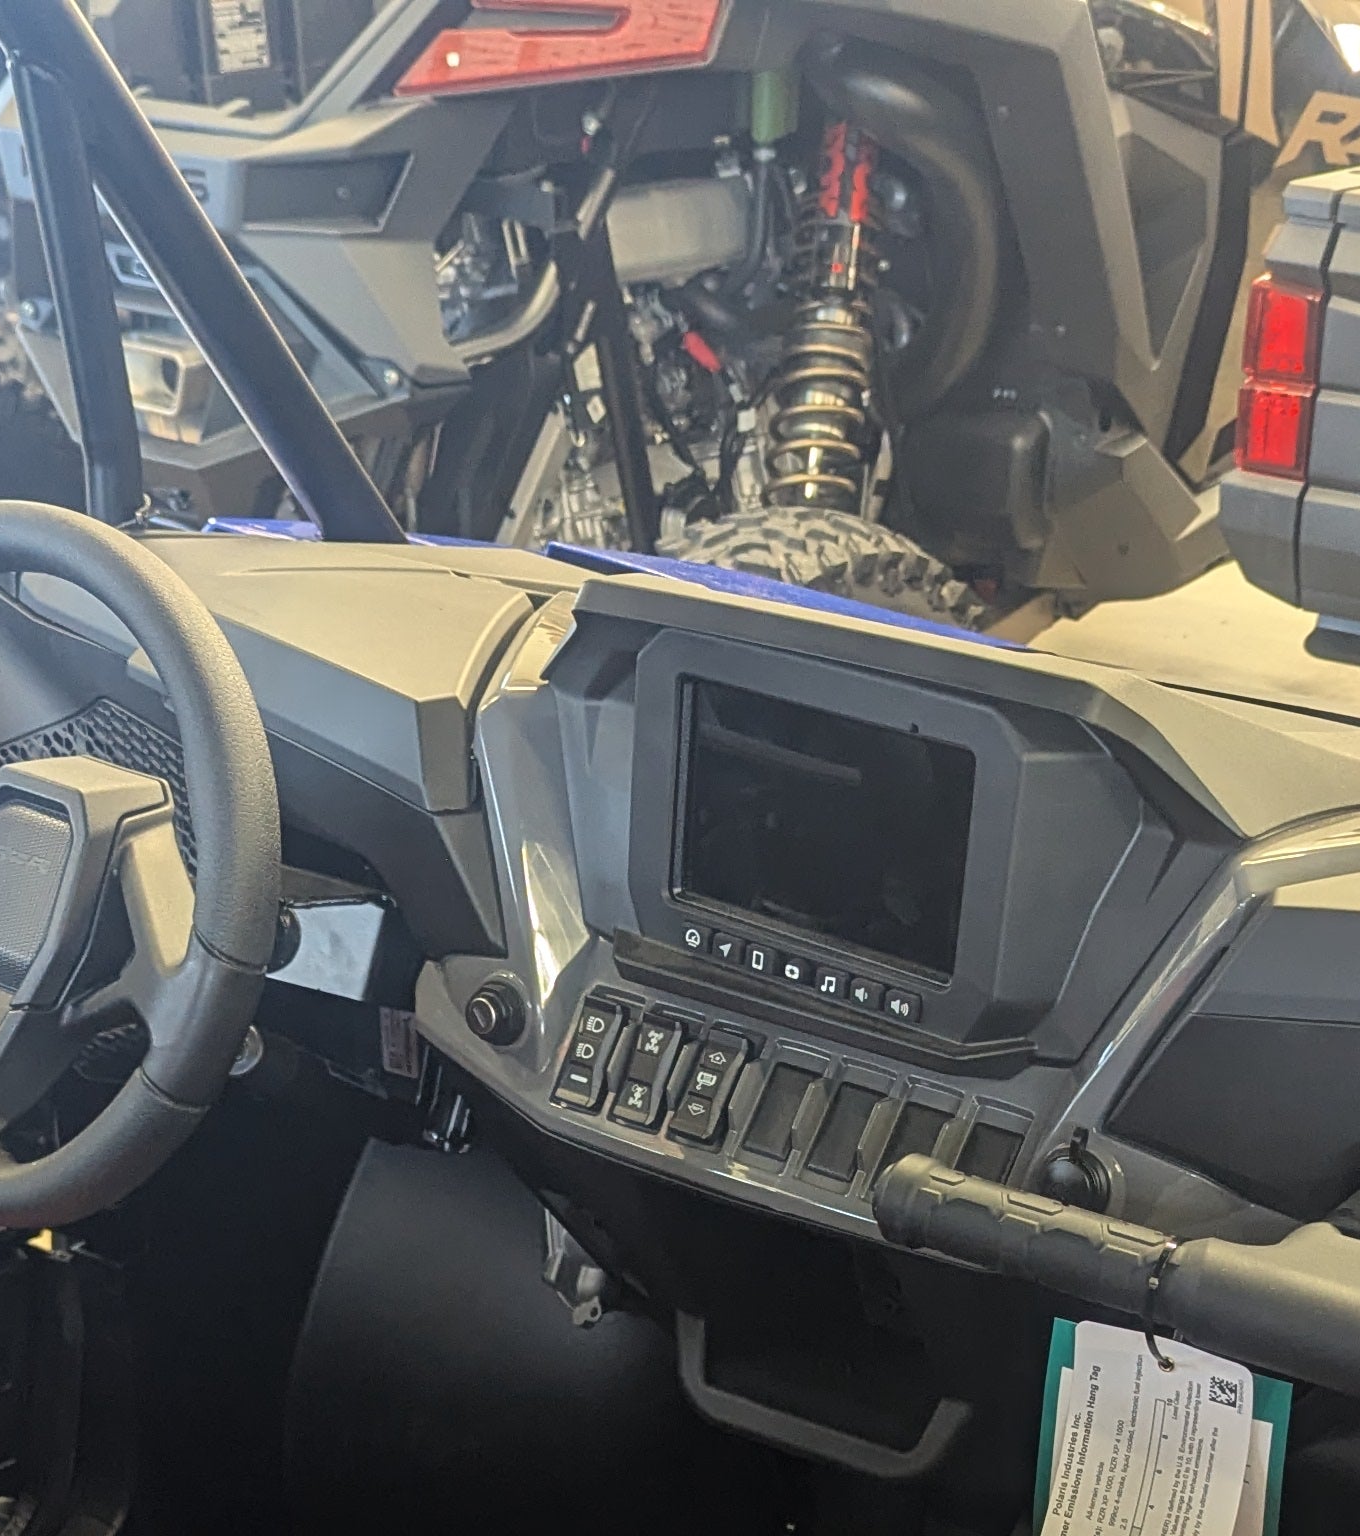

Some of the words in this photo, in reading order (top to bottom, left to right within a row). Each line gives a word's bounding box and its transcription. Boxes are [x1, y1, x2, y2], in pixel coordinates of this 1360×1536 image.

[1090, 1365, 1101, 1382] Tag
[1087, 1384, 1099, 1409] Hang
[1077, 1410, 1094, 1465] Information
[1053, 1482, 1068, 1516] Polaris
[1062, 1431, 1078, 1479] Industries
[1072, 1411, 1081, 1429] Inc.
[1064, 1468, 1083, 1519] Emissions
[1097, 1507, 1106, 1524] RZR
